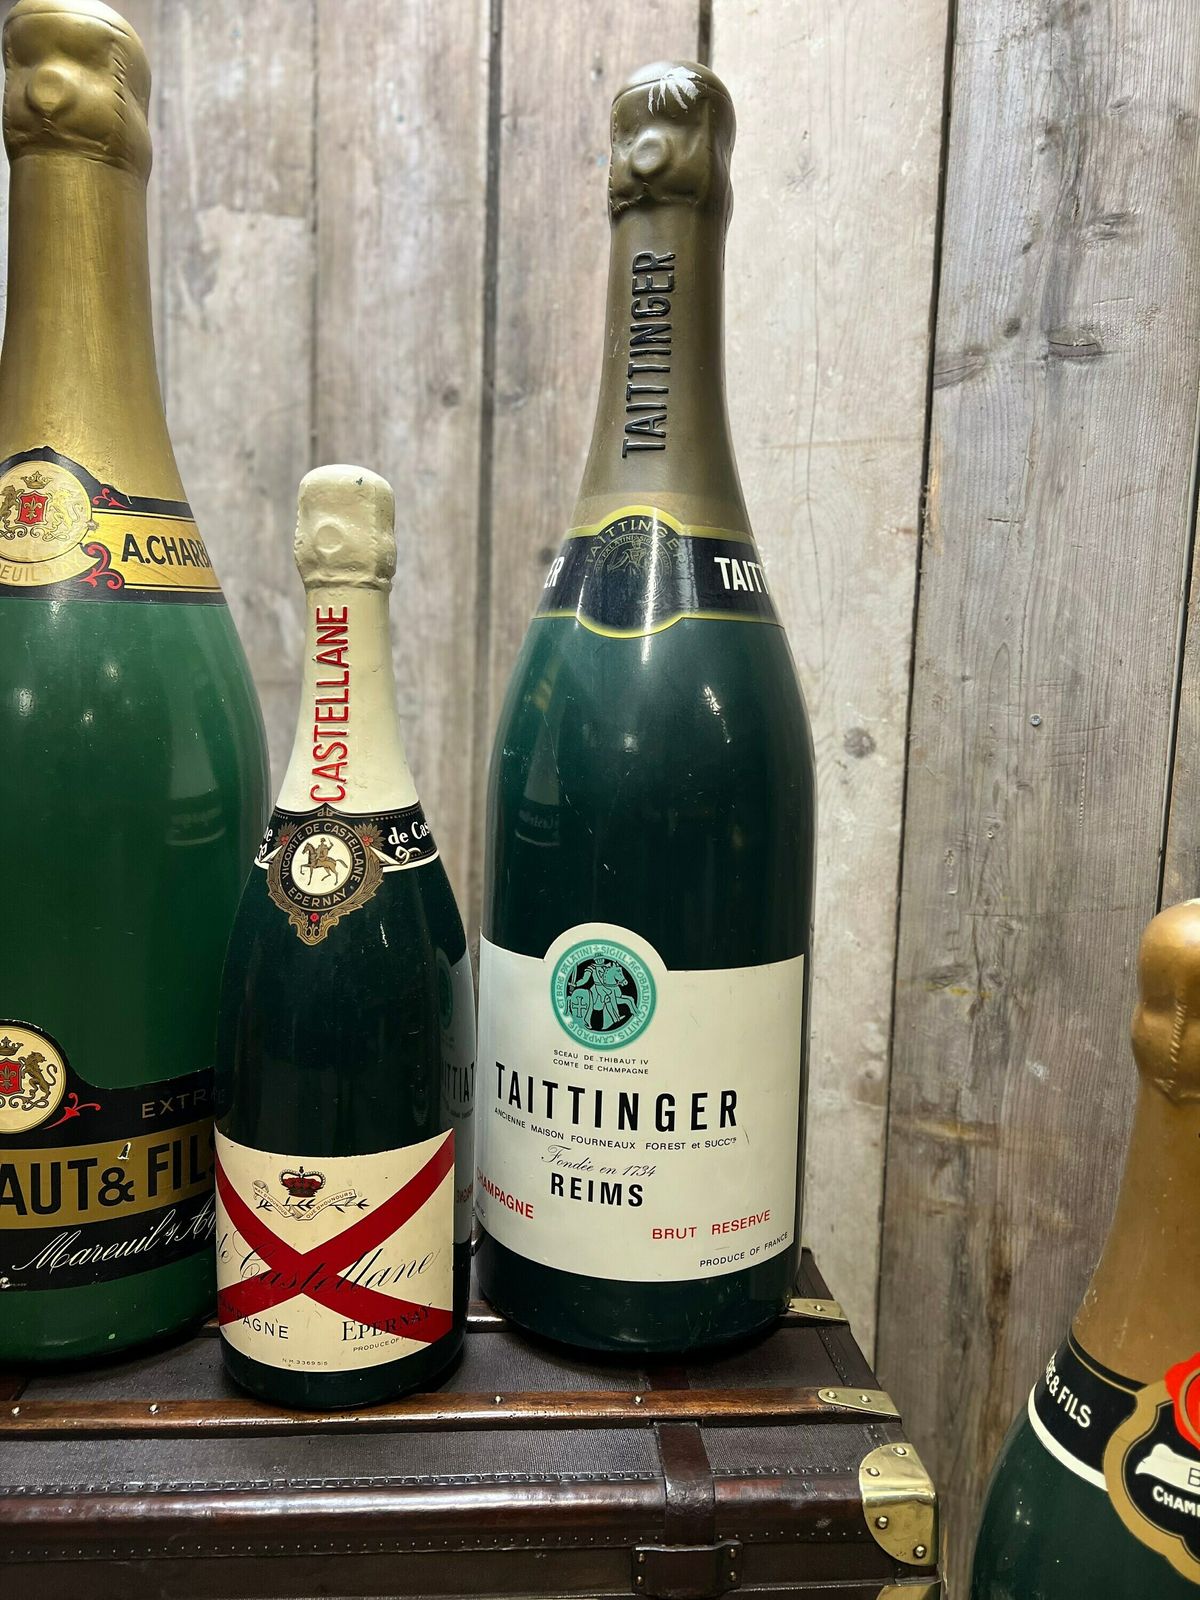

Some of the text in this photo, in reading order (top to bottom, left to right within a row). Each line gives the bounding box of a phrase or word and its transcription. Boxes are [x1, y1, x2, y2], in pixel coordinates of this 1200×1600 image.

[622, 250, 676, 459] TAITTINGER
[0, 563, 40, 582] EUIL
[310, 605, 350, 803] CASTELLANE
[281, 822, 363, 883] VICOMTE DE CASTELLANE
[387, 826, 409, 845] de
[287, 886, 346, 908] EPERNAY
[552, 1058, 649, 1075] COMTE DE CHAMPAGNE
[553, 1049, 578, 1059] SCEAU
[583, 1054, 594, 1062] DE
[600, 1056, 636, 1065] THIBAUT
[495, 1060, 738, 1132] TAITTINGER
[494, 1107, 526, 1128] ANCIENNE
[531, 1124, 564, 1140] MAISON
[571, 1134, 636, 1150] FOURNEAUX
[645, 1142, 686, 1151] FOREST
[691, 1141, 700, 1150] et
[541, 1144, 657, 1178] Fondée en 1734
[476, 1166, 534, 1219] CHAMPAGNE
[551, 1172, 643, 1208] REIMS
[12, 1208, 176, 1275] Mareuil
[652, 1209, 771, 1240] BRUT RESERVE
[699, 1231, 788, 1267] PRODUCE OF FRANCE
[352, 1340, 389, 1352] PRODUCE
[1057, 1386, 1092, 1428] FILS
